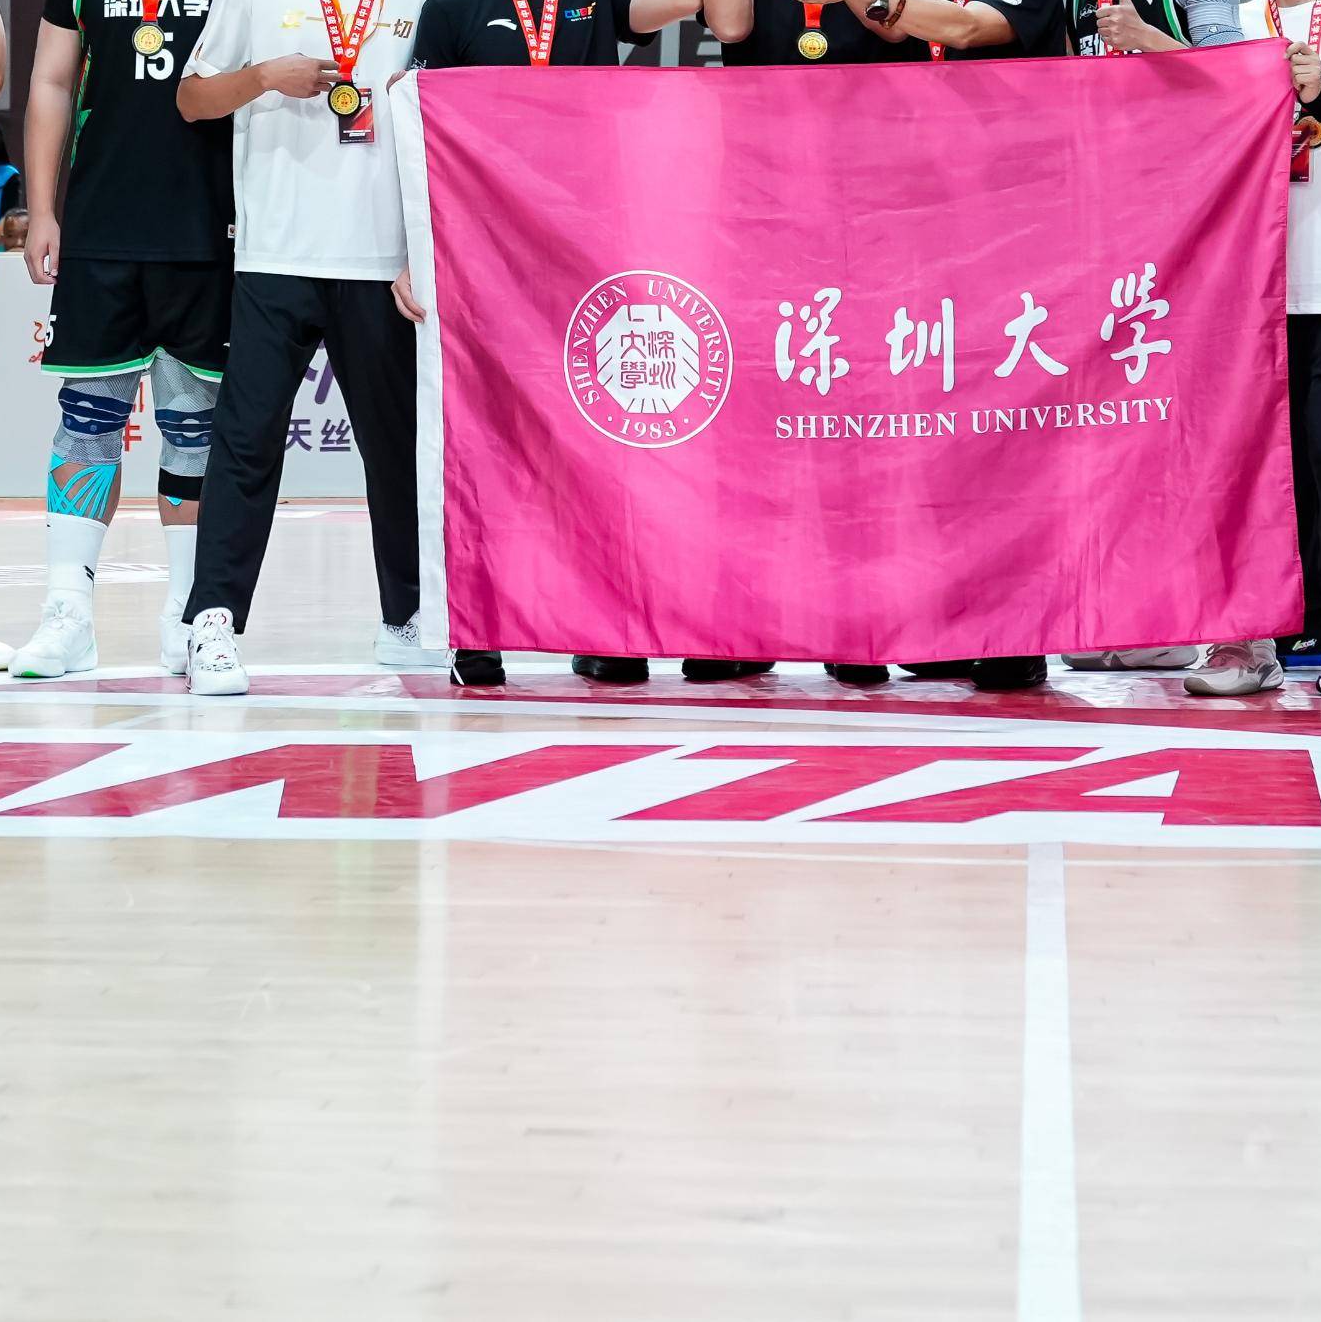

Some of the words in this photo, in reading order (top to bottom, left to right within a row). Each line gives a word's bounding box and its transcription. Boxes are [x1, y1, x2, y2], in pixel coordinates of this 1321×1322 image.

[134, 31, 175, 80] 15
[572, 281, 629, 406] SHENZHEN
[646, 279, 725, 409] UNIVERSITY
[774, 262, 1173, 396] 深圳大学
[283, 418, 352, 453] 天丝
[619, 418, 678, 439] 1983
[775, 411, 957, 439] SHENZHEN
[970, 396, 1174, 435] UNIVERSITY
